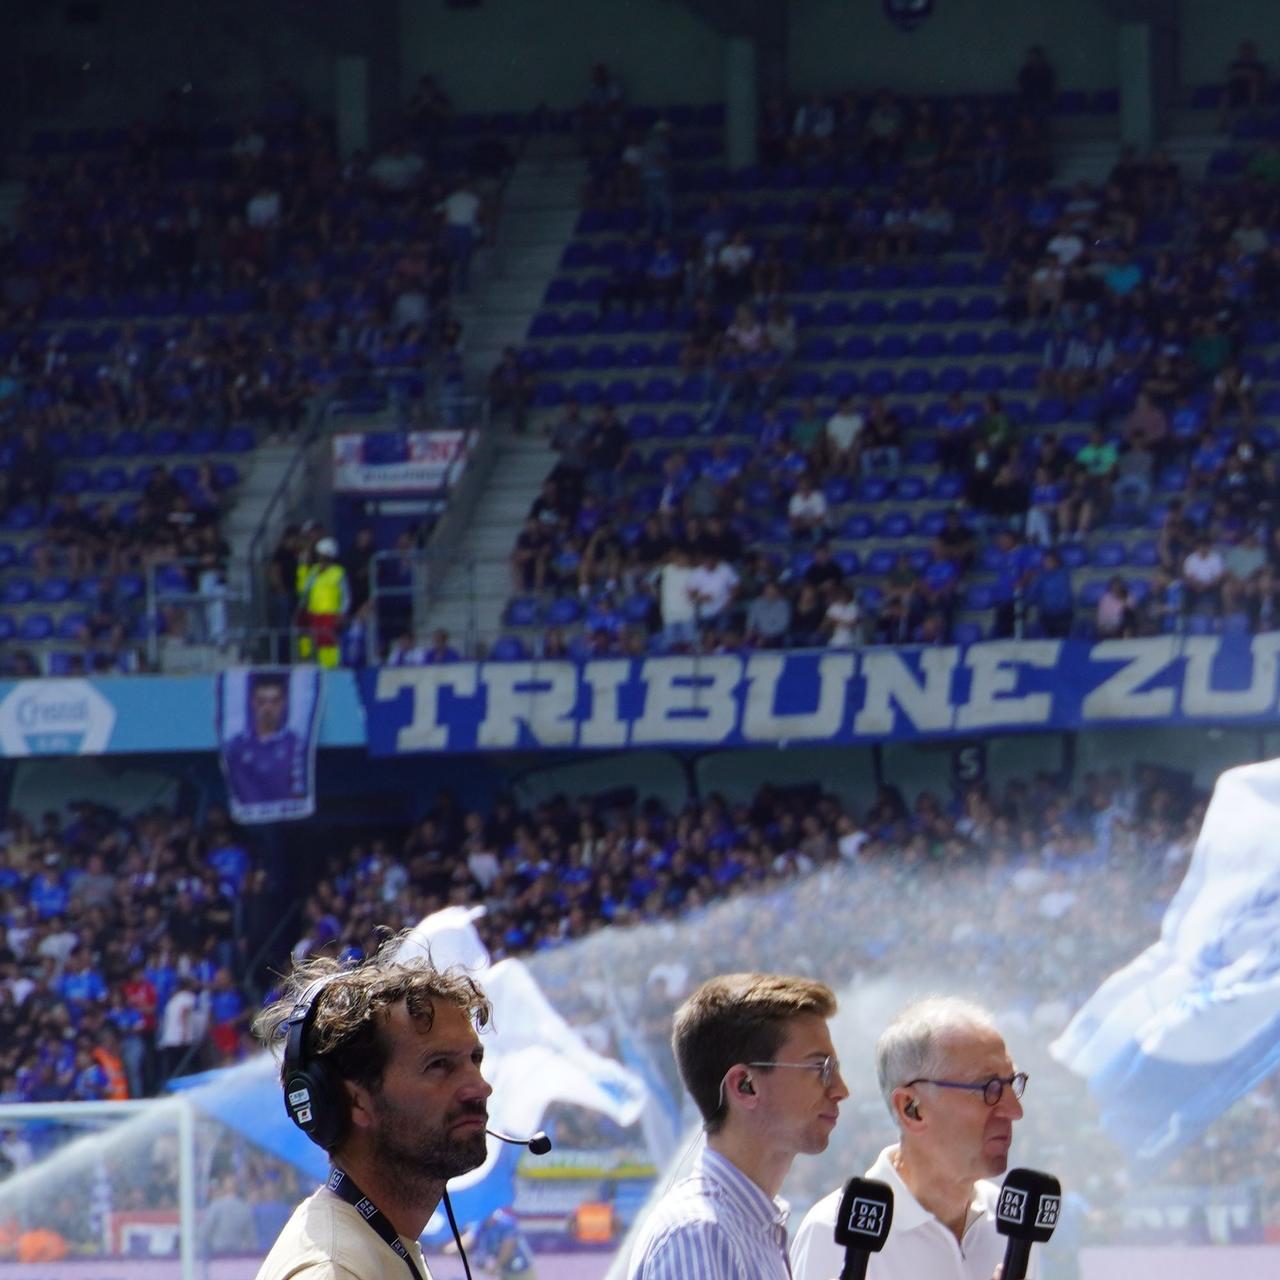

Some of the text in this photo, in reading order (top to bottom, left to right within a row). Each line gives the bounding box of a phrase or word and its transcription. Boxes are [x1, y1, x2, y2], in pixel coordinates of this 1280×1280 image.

[376, 638, 1061, 752] TRIBUNE
[859, 1204, 878, 1218] DA
[857, 1217, 877, 1231] ZN
